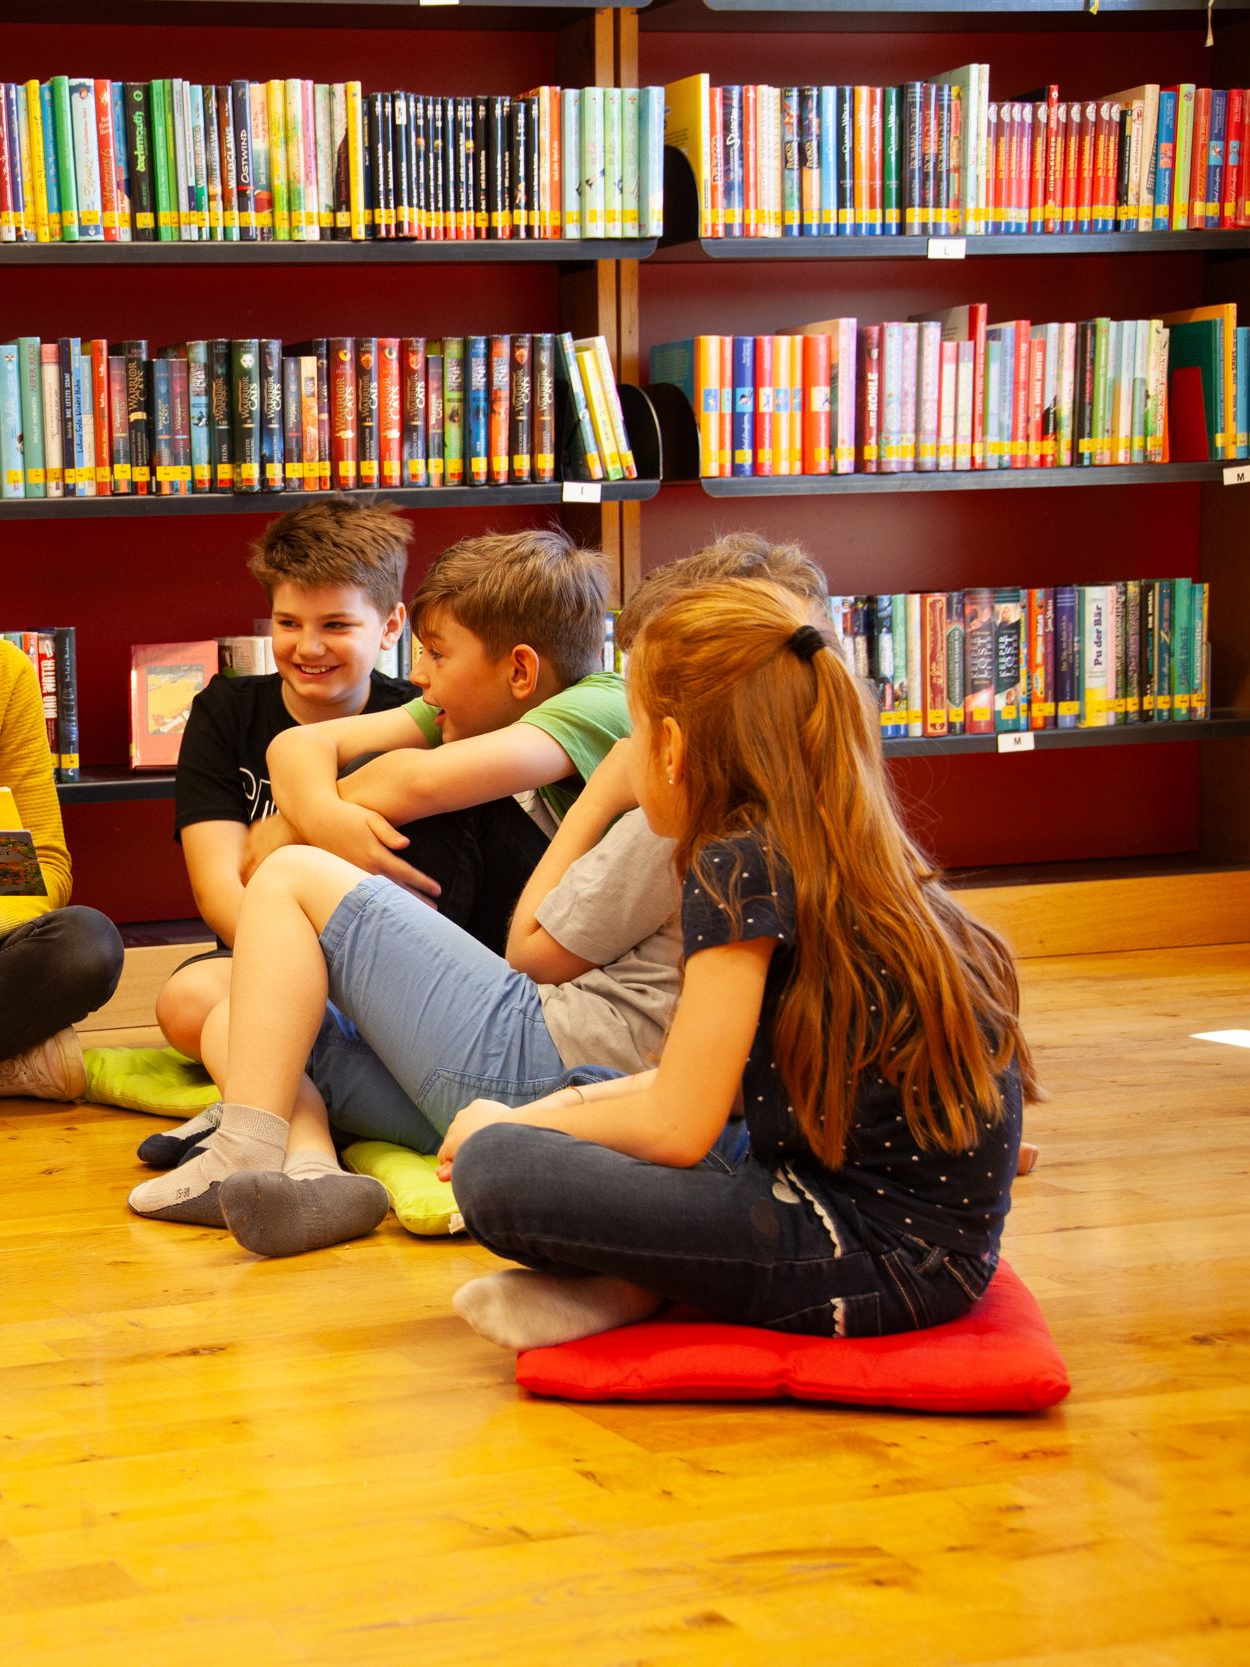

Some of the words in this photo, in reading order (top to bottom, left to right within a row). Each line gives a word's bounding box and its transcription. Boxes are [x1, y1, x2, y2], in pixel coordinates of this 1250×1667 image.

[240, 129, 250, 184] OSTWIND
[129, 361, 139, 410] WARRIOR
[241, 375, 252, 419] WARRIOR
[250, 383, 259, 411] CATS
[370, 381, 379, 410] CATS
[417, 380, 426, 409] CATS
[523, 376, 532, 404] CATS
[346, 386, 356, 421] CATS
[391, 385, 401, 421] CATS
[1237, 472, 1245, 482] M
[1093, 604, 1102, 627] Bär
[1093, 629, 1102, 649] der
[1093, 650, 1103, 666] Pu
[1013, 737, 1022, 746] M
